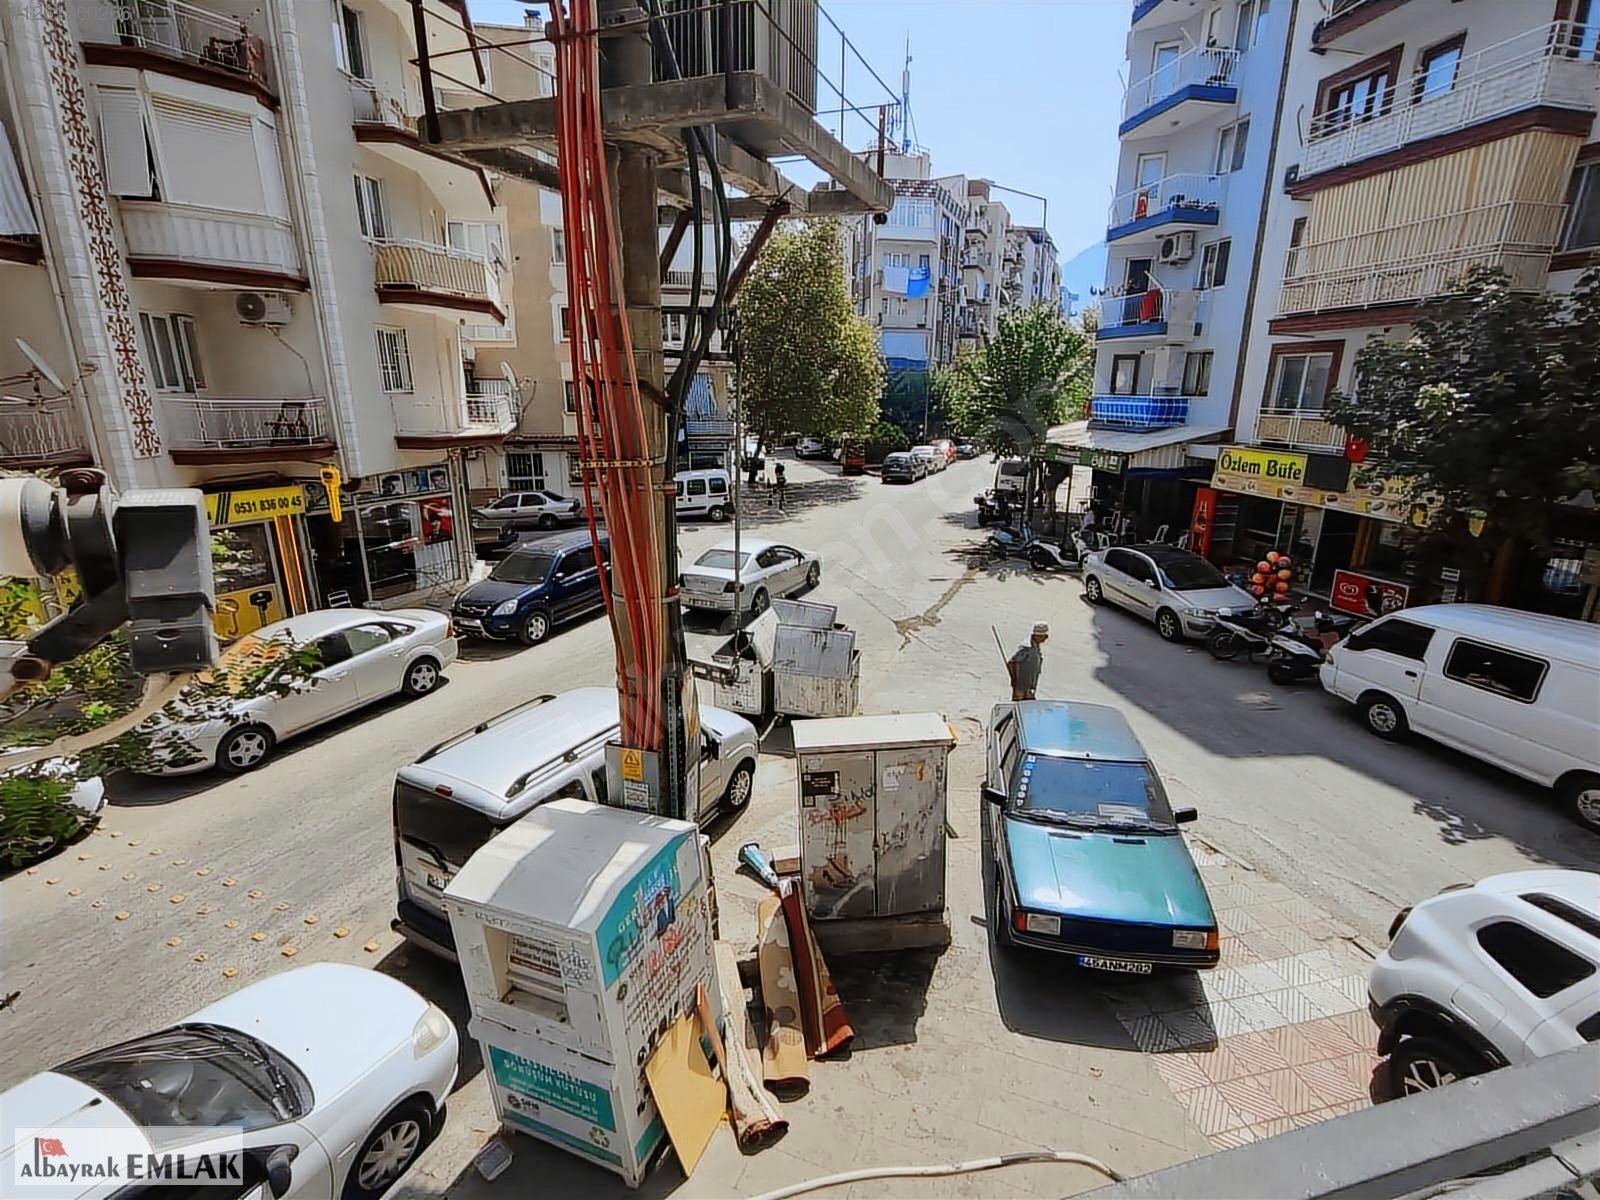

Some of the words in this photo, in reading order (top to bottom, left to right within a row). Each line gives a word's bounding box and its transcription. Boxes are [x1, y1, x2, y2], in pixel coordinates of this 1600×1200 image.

[1221, 450, 1260, 475] Özlem
[1266, 460, 1302, 480] Büfe
[234, 501, 257, 514] 0531
[260, 499, 277, 511] 836
[278, 498, 289, 509] 00
[291, 496, 302, 506] 45
